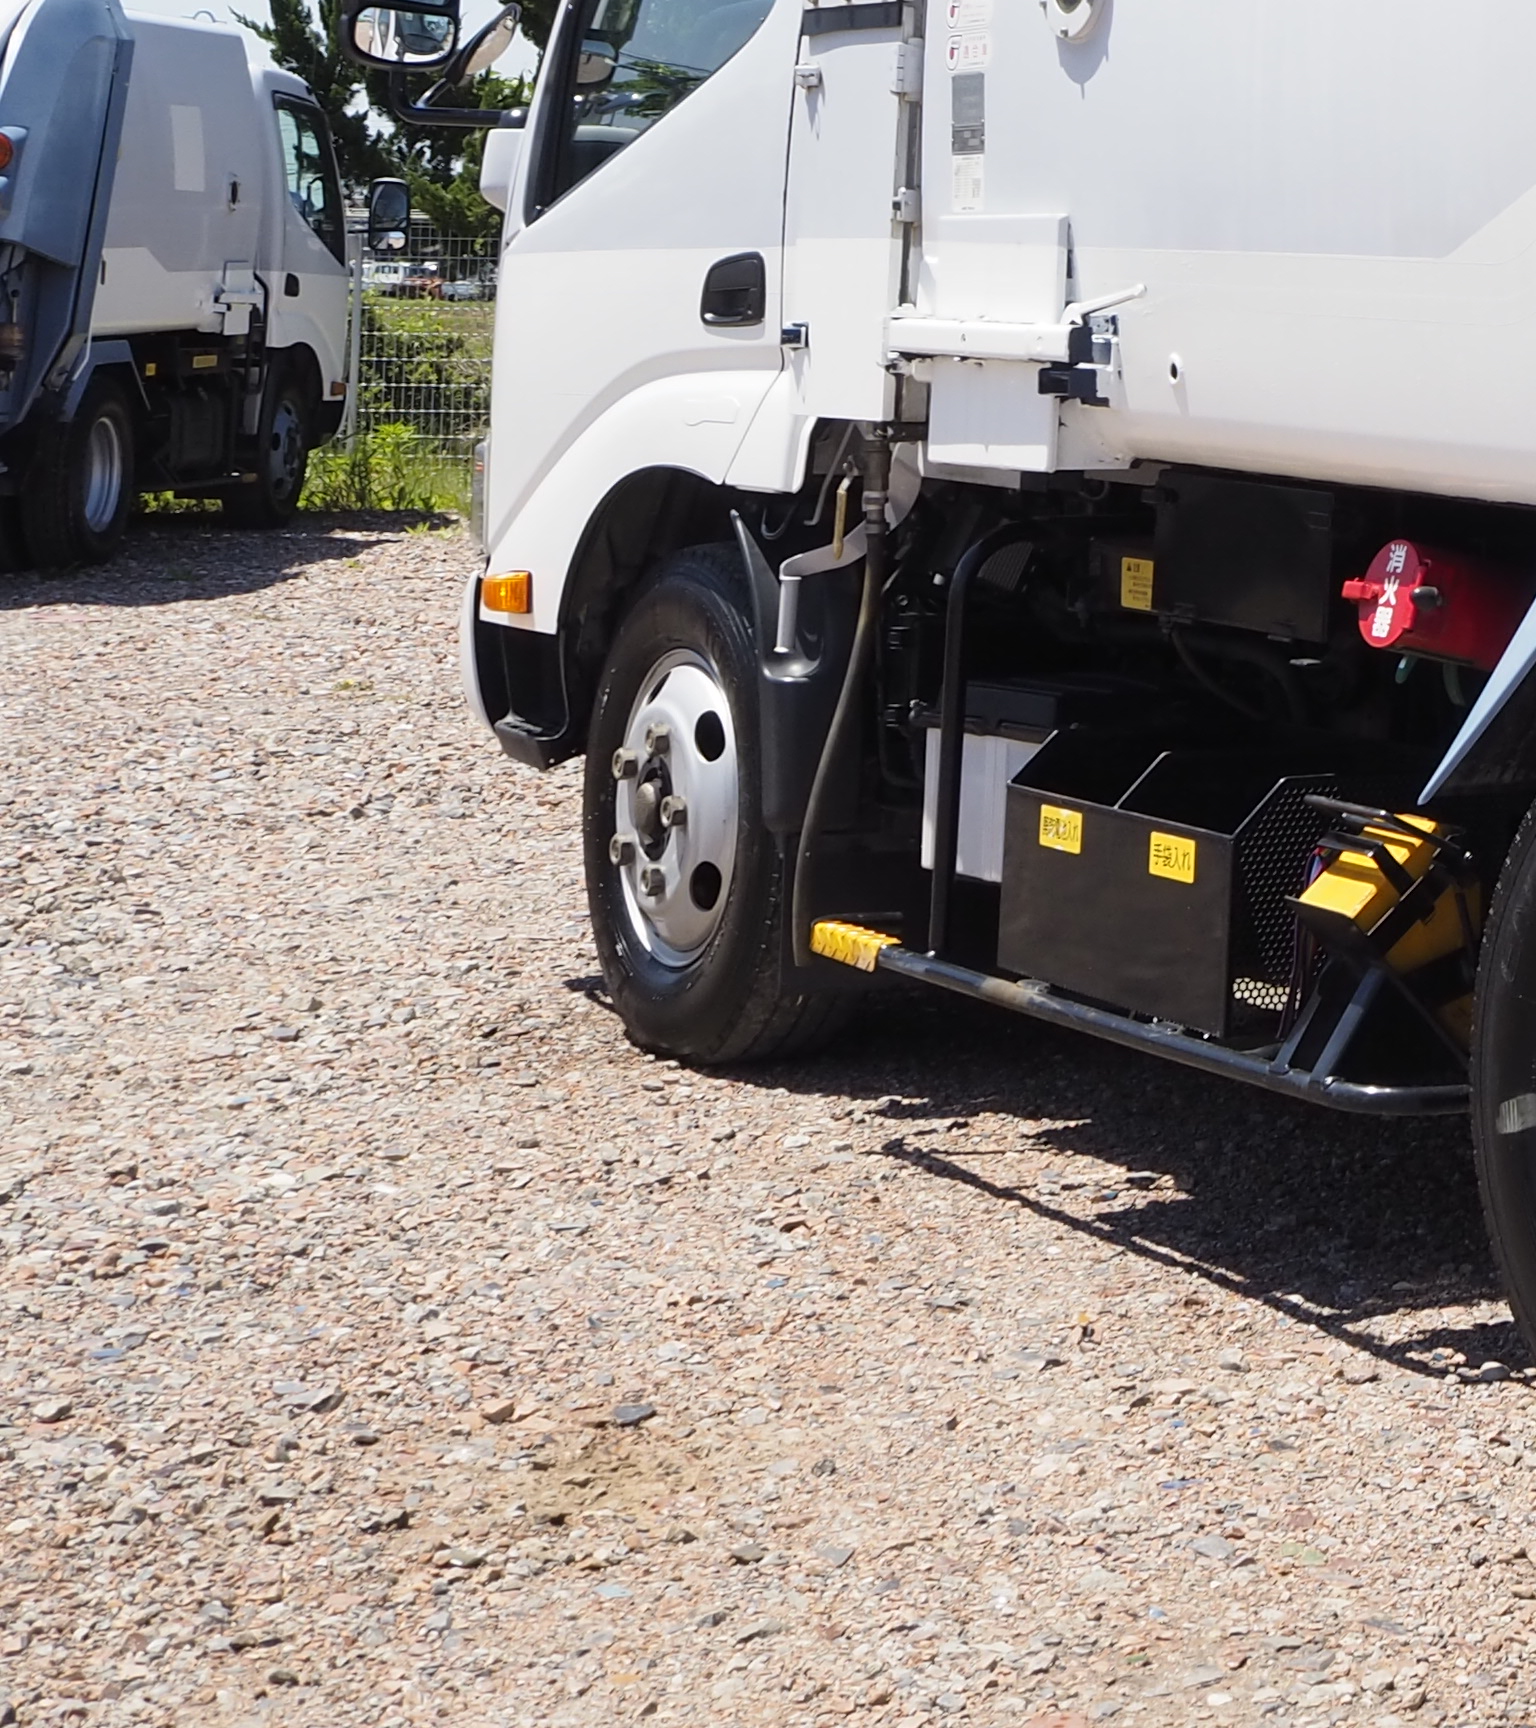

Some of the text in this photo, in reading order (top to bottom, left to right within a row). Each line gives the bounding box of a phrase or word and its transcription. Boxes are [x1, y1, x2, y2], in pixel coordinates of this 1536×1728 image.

[1371, 543, 1408, 639] 消火器
[1152, 843, 1192, 872] 手袋入れ
